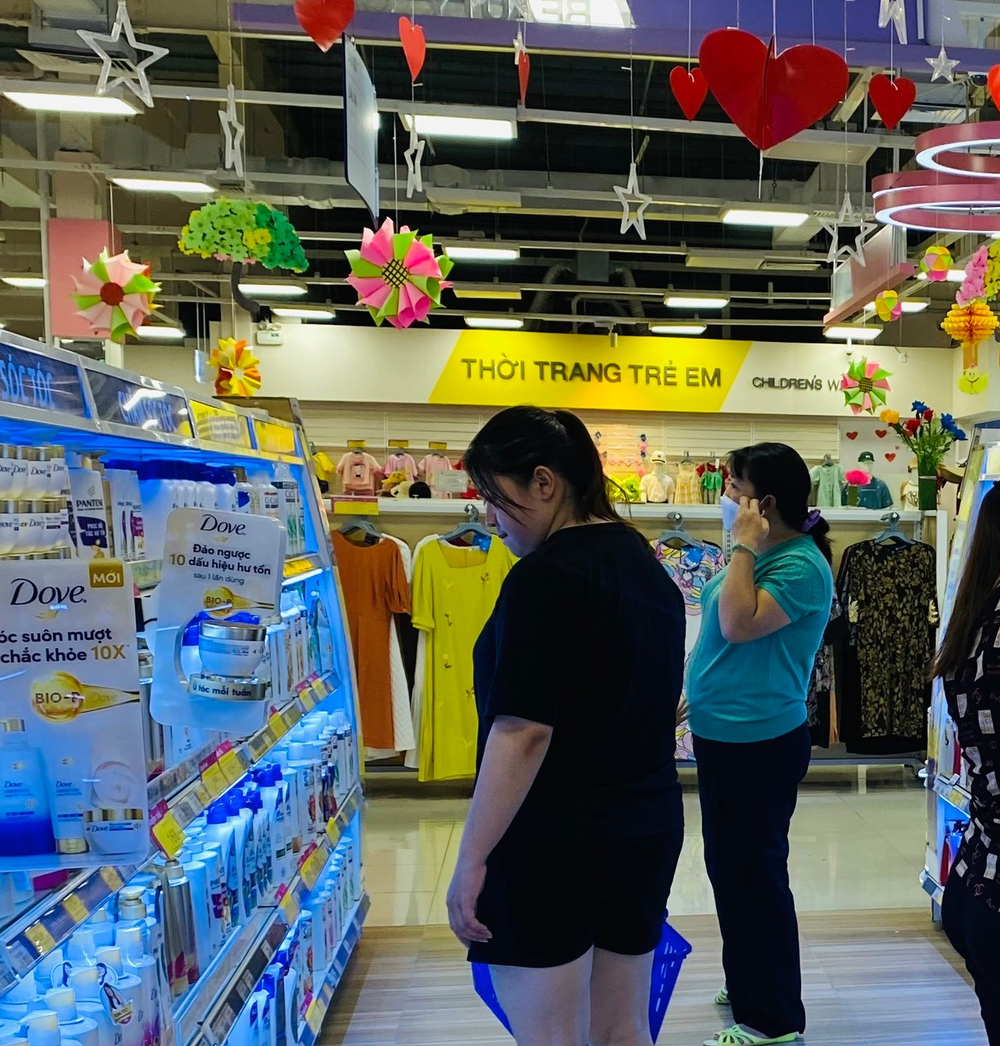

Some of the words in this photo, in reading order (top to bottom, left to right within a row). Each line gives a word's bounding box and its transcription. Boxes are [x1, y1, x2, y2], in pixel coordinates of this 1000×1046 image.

[461, 353, 526, 381] THỜI
[533, 361, 622, 384] TRANG
[628, 360, 678, 387] TRẺ
[686, 367, 722, 388] EM
[752, 375, 823, 391] CHILDREN'S
[200, 514, 246, 536] Dove
[193, 544, 215, 555] Đảo
[217, 548, 251, 561] ngược
[170, 553, 186, 566] 10
[211, 559, 235, 572] hiệu
[93, 570, 120, 584] MỚI
[193, 572, 206, 580] sau
[10, 578, 87, 605] Dove
[0, 626, 17, 644] óc
[22, 629, 63, 642] suôn
[67, 628, 112, 645] mượt
[0, 646, 41, 664] chắc
[45, 647, 87, 662] khỏe
[91, 644, 126, 660] 10X
